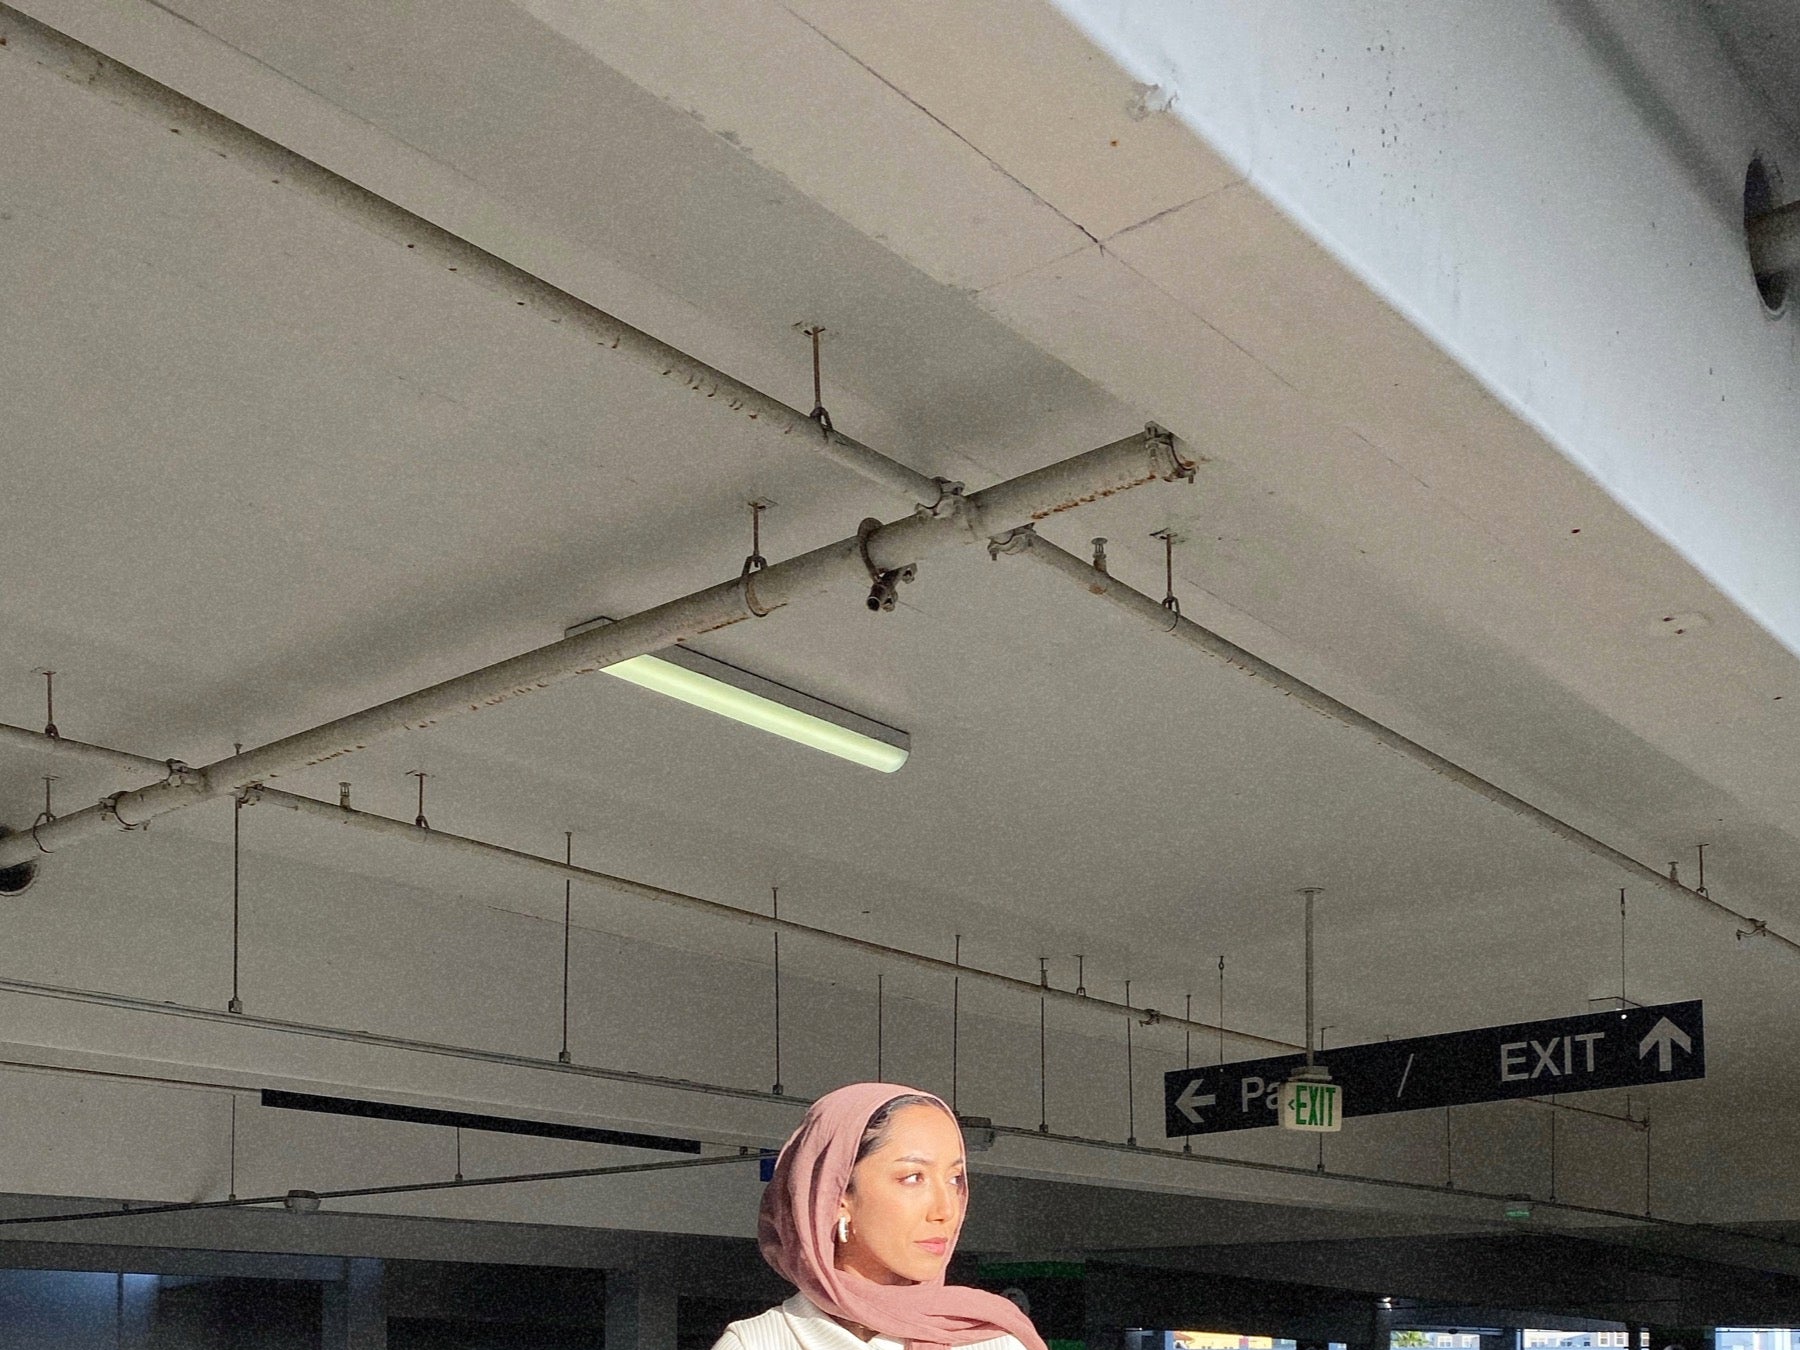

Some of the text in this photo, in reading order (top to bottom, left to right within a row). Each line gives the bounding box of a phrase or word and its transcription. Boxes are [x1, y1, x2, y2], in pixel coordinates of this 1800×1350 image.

[1500, 1031, 1605, 1082] EXIT
[1241, 1076, 1280, 1113] Pa
[1295, 1084, 1336, 1127] EXIT
